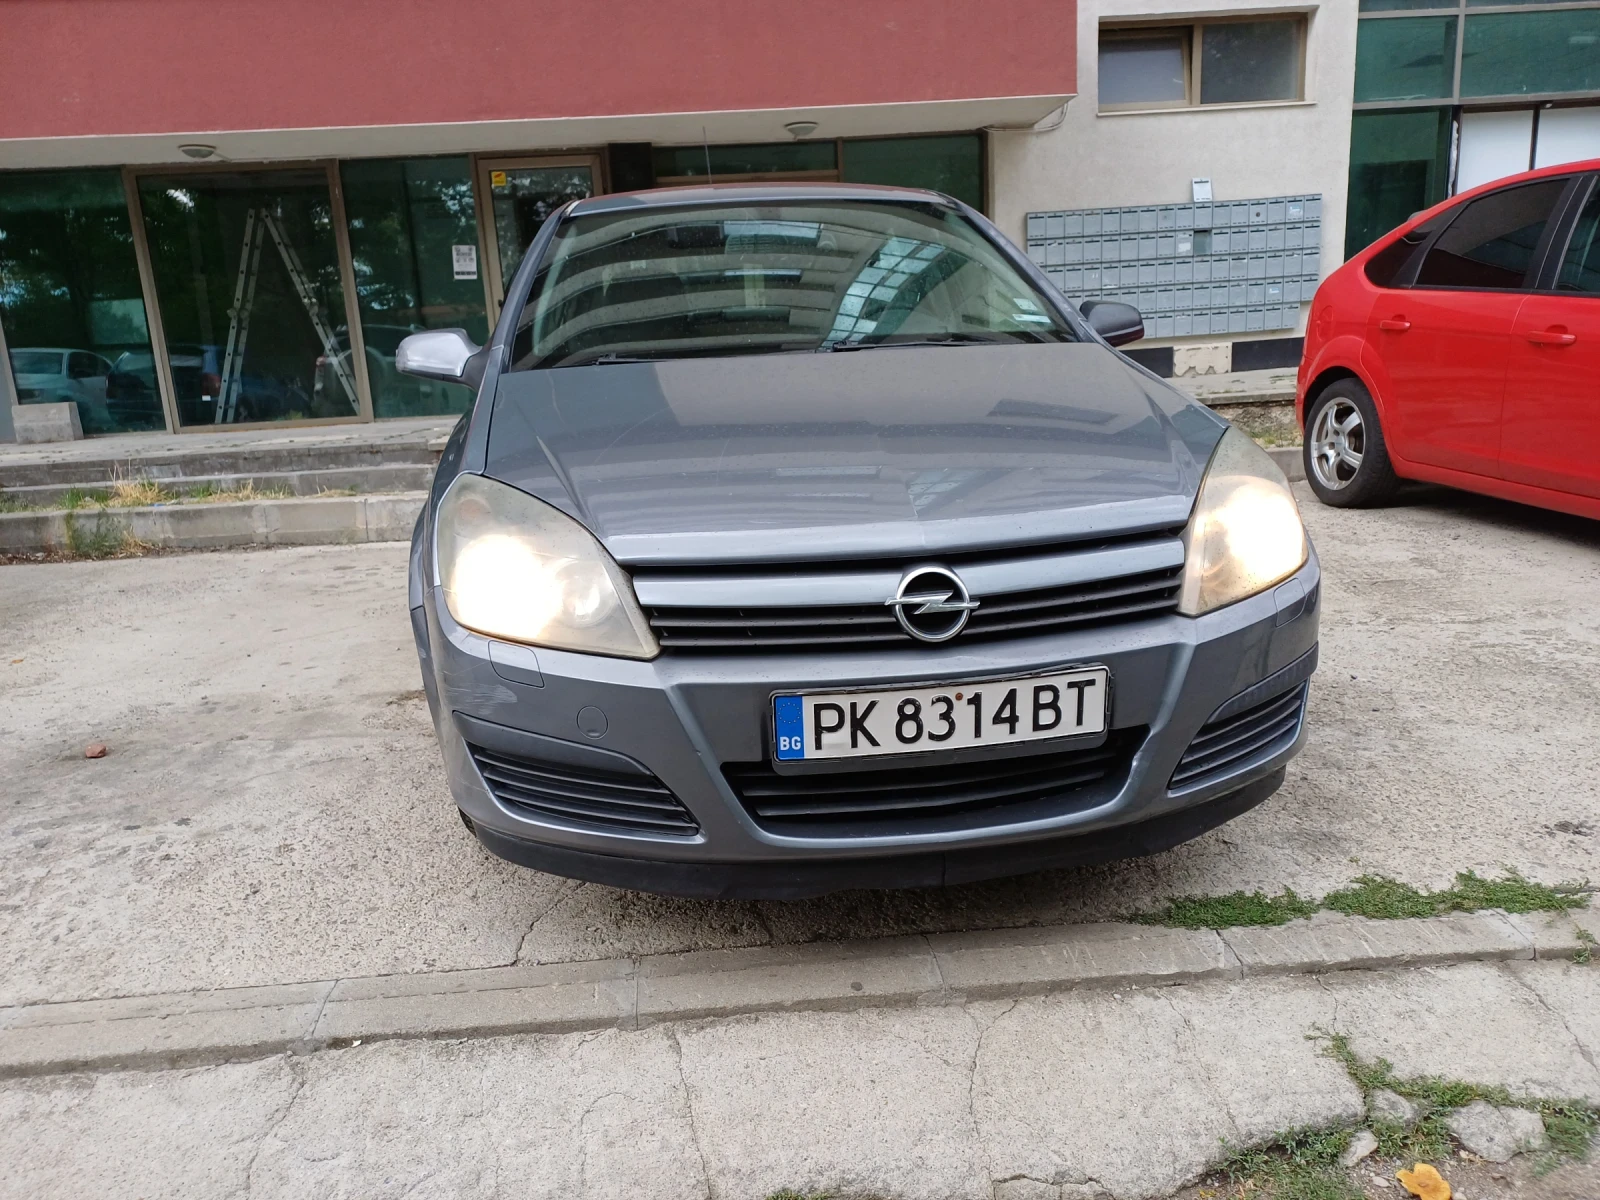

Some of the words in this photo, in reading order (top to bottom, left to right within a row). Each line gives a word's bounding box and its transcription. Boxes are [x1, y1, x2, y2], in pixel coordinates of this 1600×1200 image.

[814, 700, 881, 750] PK
[895, 689, 1019, 744] 8314
[1032, 679, 1096, 732] BT
[779, 736, 802, 751] BG
